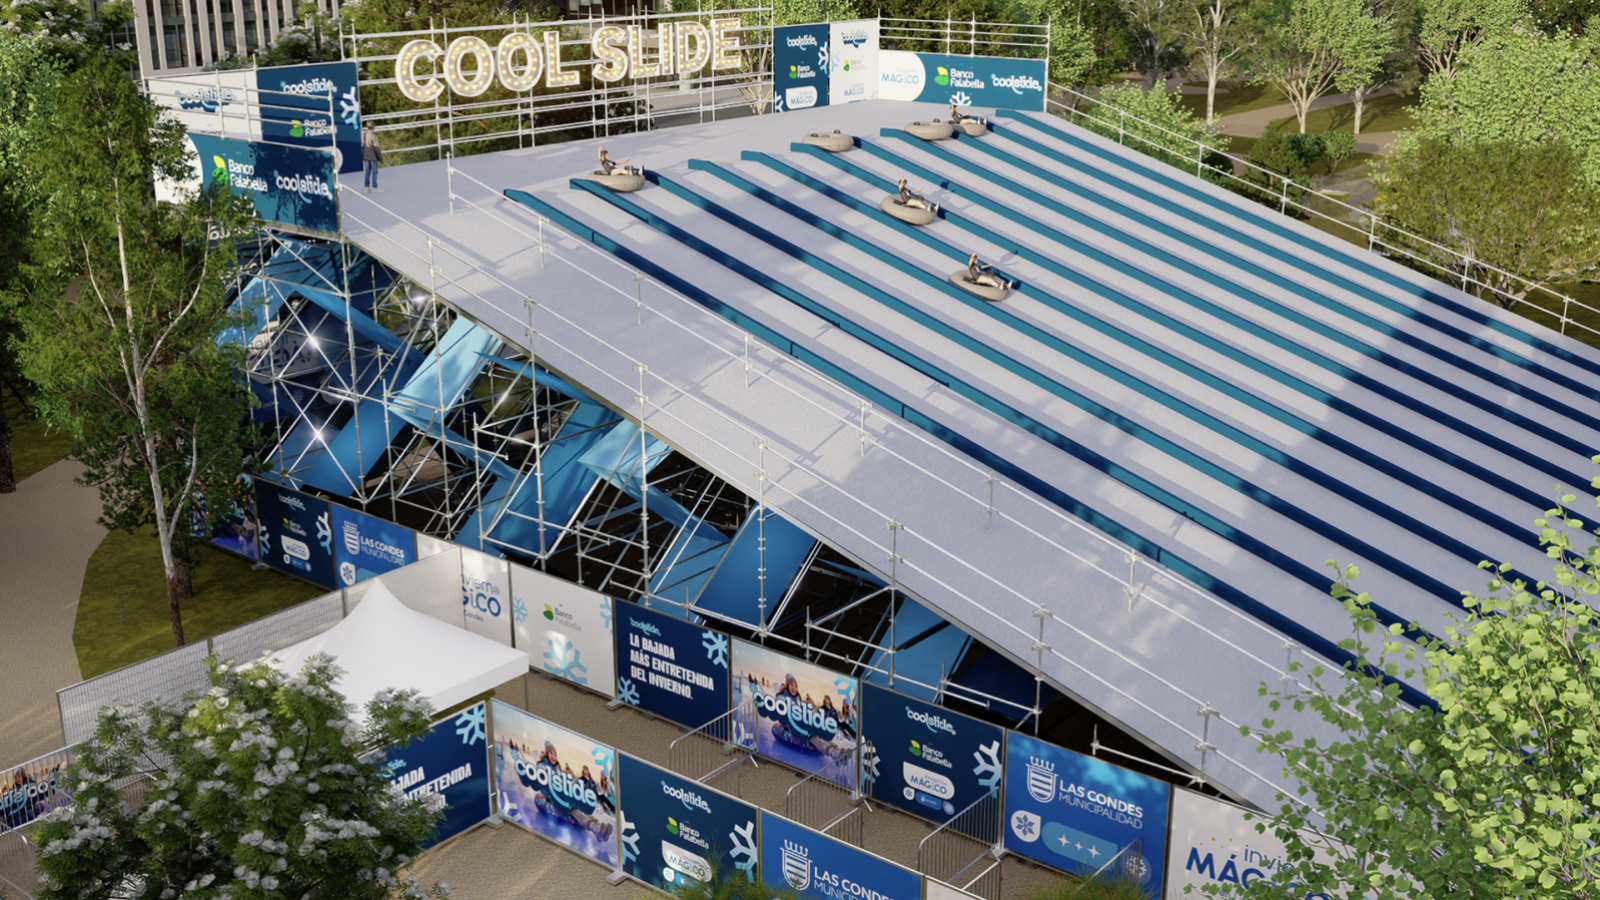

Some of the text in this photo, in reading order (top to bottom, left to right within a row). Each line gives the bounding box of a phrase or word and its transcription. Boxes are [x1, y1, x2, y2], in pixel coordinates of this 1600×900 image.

[395, 18, 742, 102] COOL SLIDE
[950, 68, 974, 79] Banco
[950, 77, 985, 89] Falabella
[993, 74, 1039, 94] coolslide
[228, 158, 255, 175] Banco
[230, 174, 268, 192] Falabella
[276, 174, 330, 204] coolslide
[360, 536, 404, 558] LAS CONDES
[361, 546, 405, 566] MUNICIPALIDAD
[554, 607, 573, 621] Banco
[554, 616, 582, 632] Falabella
[630, 633, 676, 661] LA BAJADA
[630, 649, 715, 691] MÁS ENTRETENIDA
[631, 665, 693, 701] DEL INVIERNO.
[754, 693, 838, 735] coolslide
[907, 709, 953, 733] coolslide
[922, 744, 943, 758] Banco
[922, 753, 952, 768] Falabella
[390, 766, 424, 795] AJADA
[404, 763, 473, 804] NTRETENIDA
[515, 757, 597, 808] coolslide
[663, 783, 709, 810] coolslide
[1059, 779, 1143, 818] LAS CONDES
[1059, 792, 1142, 829] MUNICIPALIDAD
[679, 822, 700, 838] Banco
[679, 830, 709, 849] Falabella
[814, 867, 839, 886] LAS
